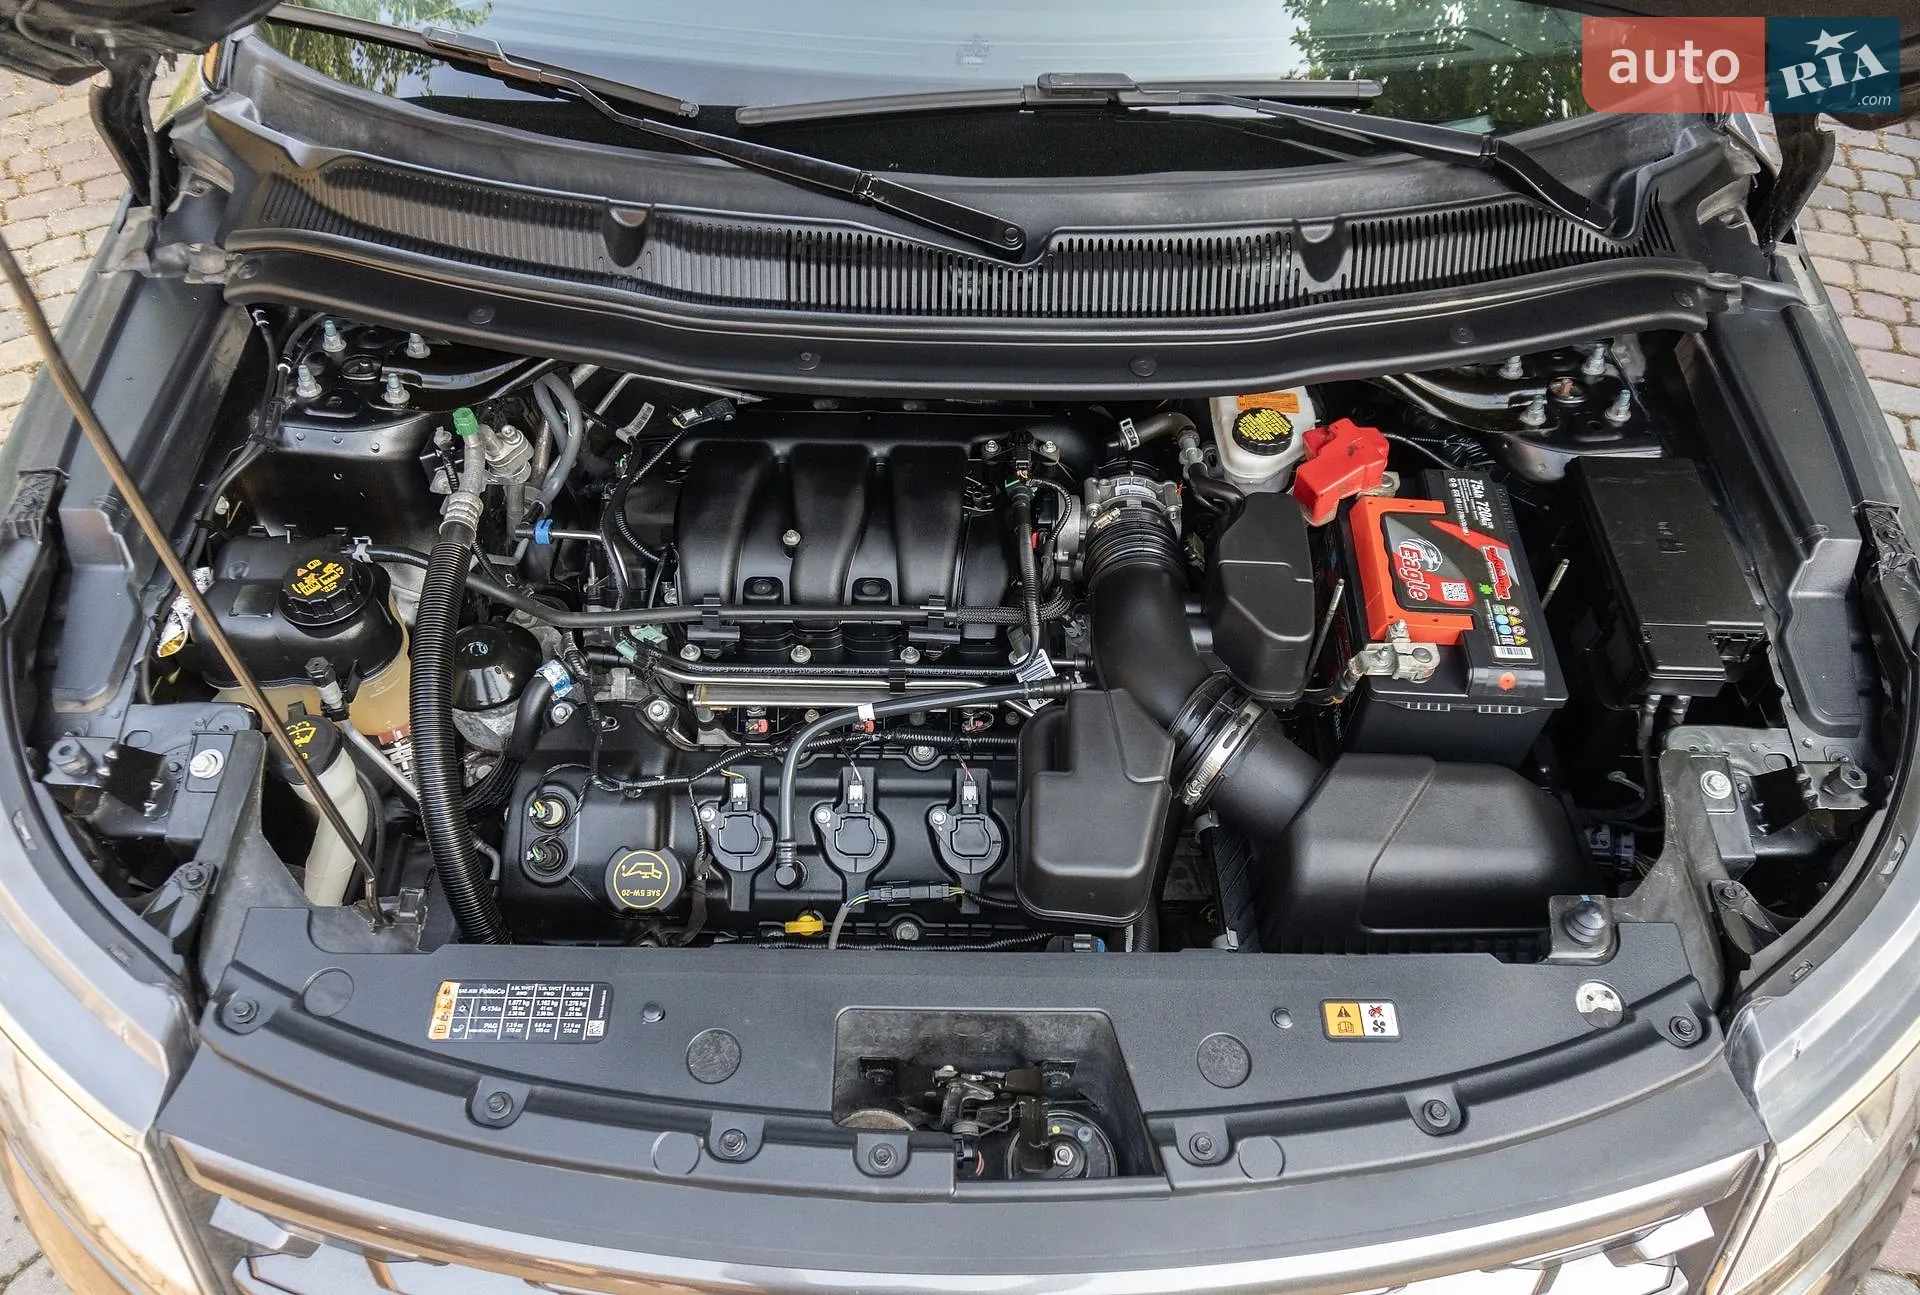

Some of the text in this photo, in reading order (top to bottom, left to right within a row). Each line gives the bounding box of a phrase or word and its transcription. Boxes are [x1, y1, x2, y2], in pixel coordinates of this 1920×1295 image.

[1399, 546, 1431, 601] Eagle
[621, 889, 661, 897] SAE 5W-20
